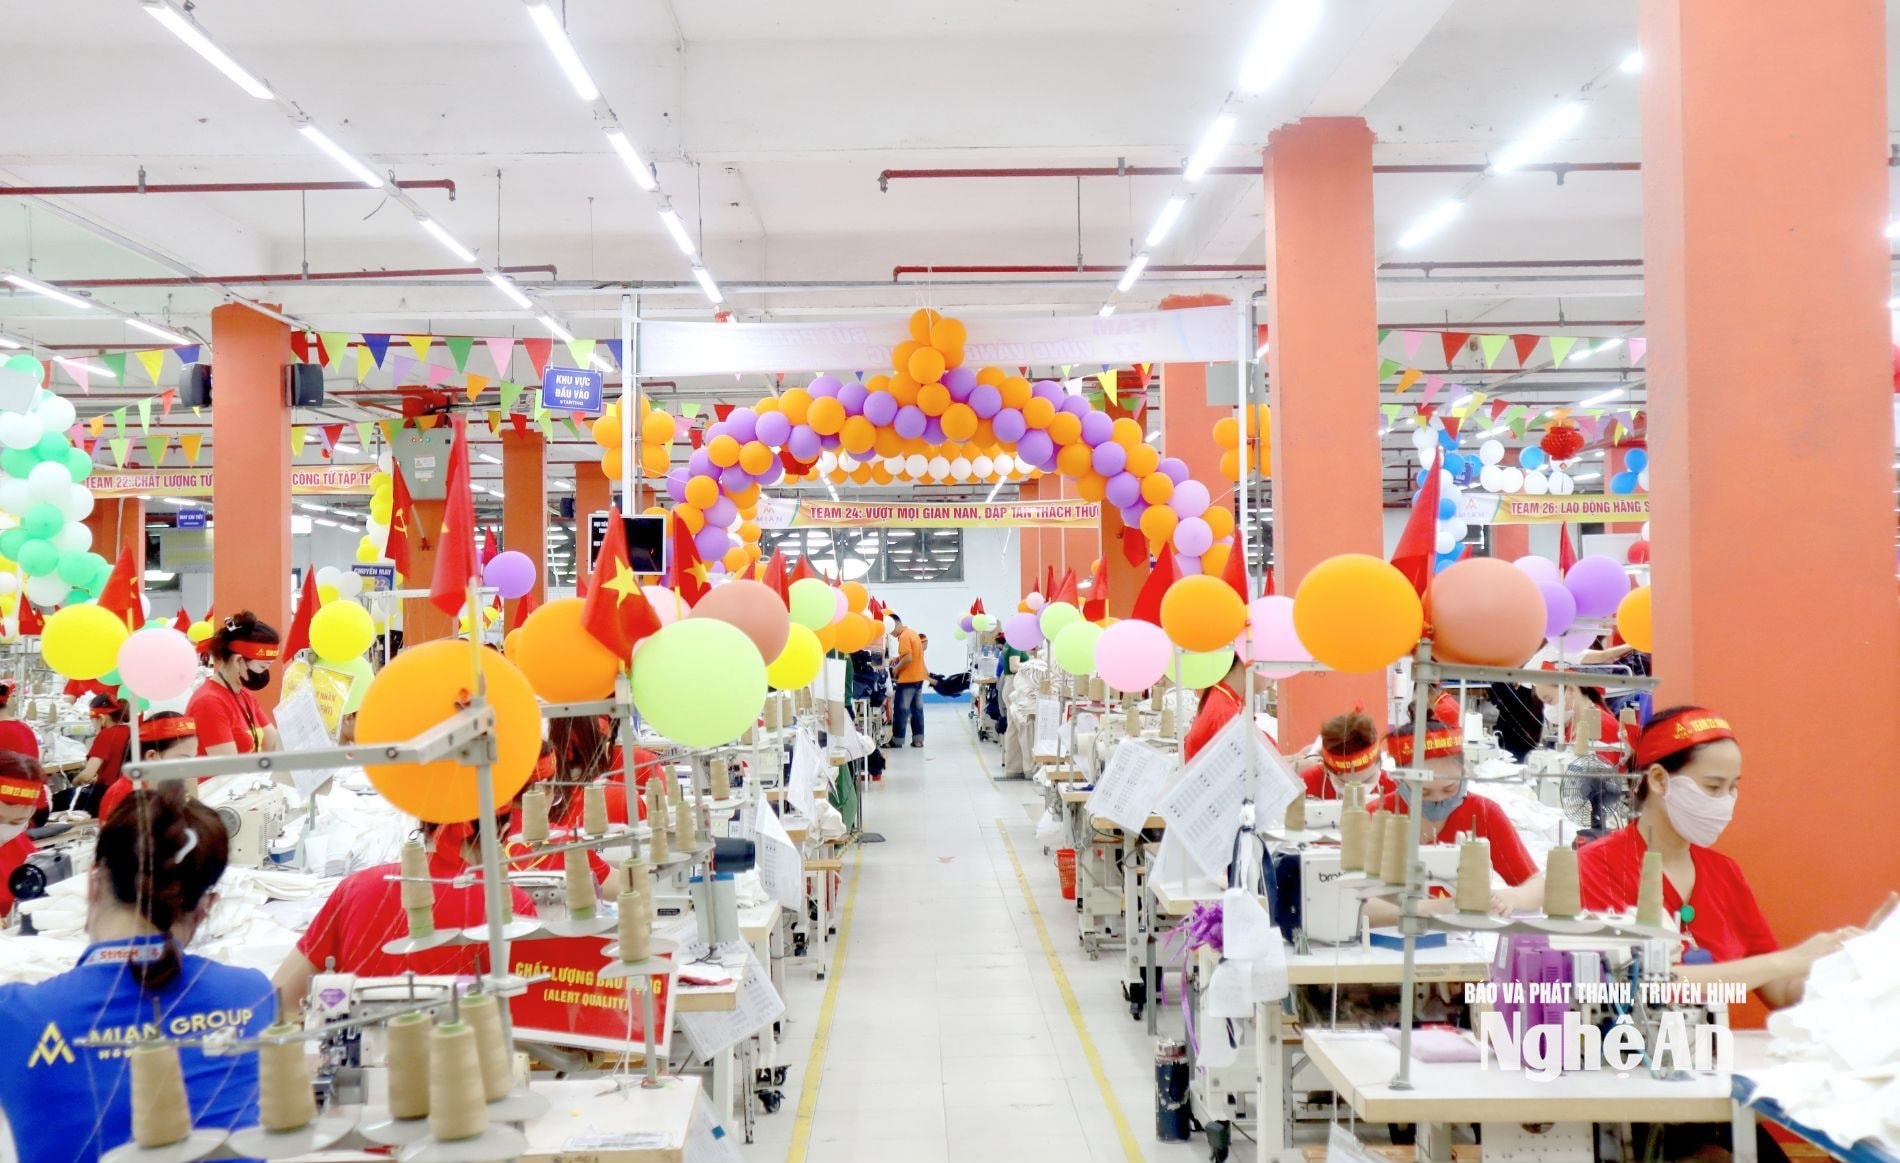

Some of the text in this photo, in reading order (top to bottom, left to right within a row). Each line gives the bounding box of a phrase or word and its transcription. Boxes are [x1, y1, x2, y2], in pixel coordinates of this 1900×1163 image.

[556, 375, 591, 387] KHU VỰC
[86, 477, 113, 489] TEAM
[163, 475, 197, 489] LƯỢNG
[811, 507, 842, 519] TEAM
[845, 507, 862, 519] 24:
[866, 505, 893, 521] VƯỢT
[897, 507, 919, 521] MỌI
[923, 507, 950, 519] GIAN
[954, 507, 981, 520] NAN,
[1011, 506, 1031, 519] TAN
[1036, 504, 1071, 519] THÁCH
[1511, 502, 1539, 514] TEAM
[1542, 502, 1558, 513] 26:
[1561, 502, 1579, 513] LAO
[1583, 500, 1610, 515] ĐỘNG
[552, 966, 594, 986] LƯỢNG
[544, 988, 629, 1011] (ALERT QUALITY)
[170, 1009, 253, 1035] GROUP
